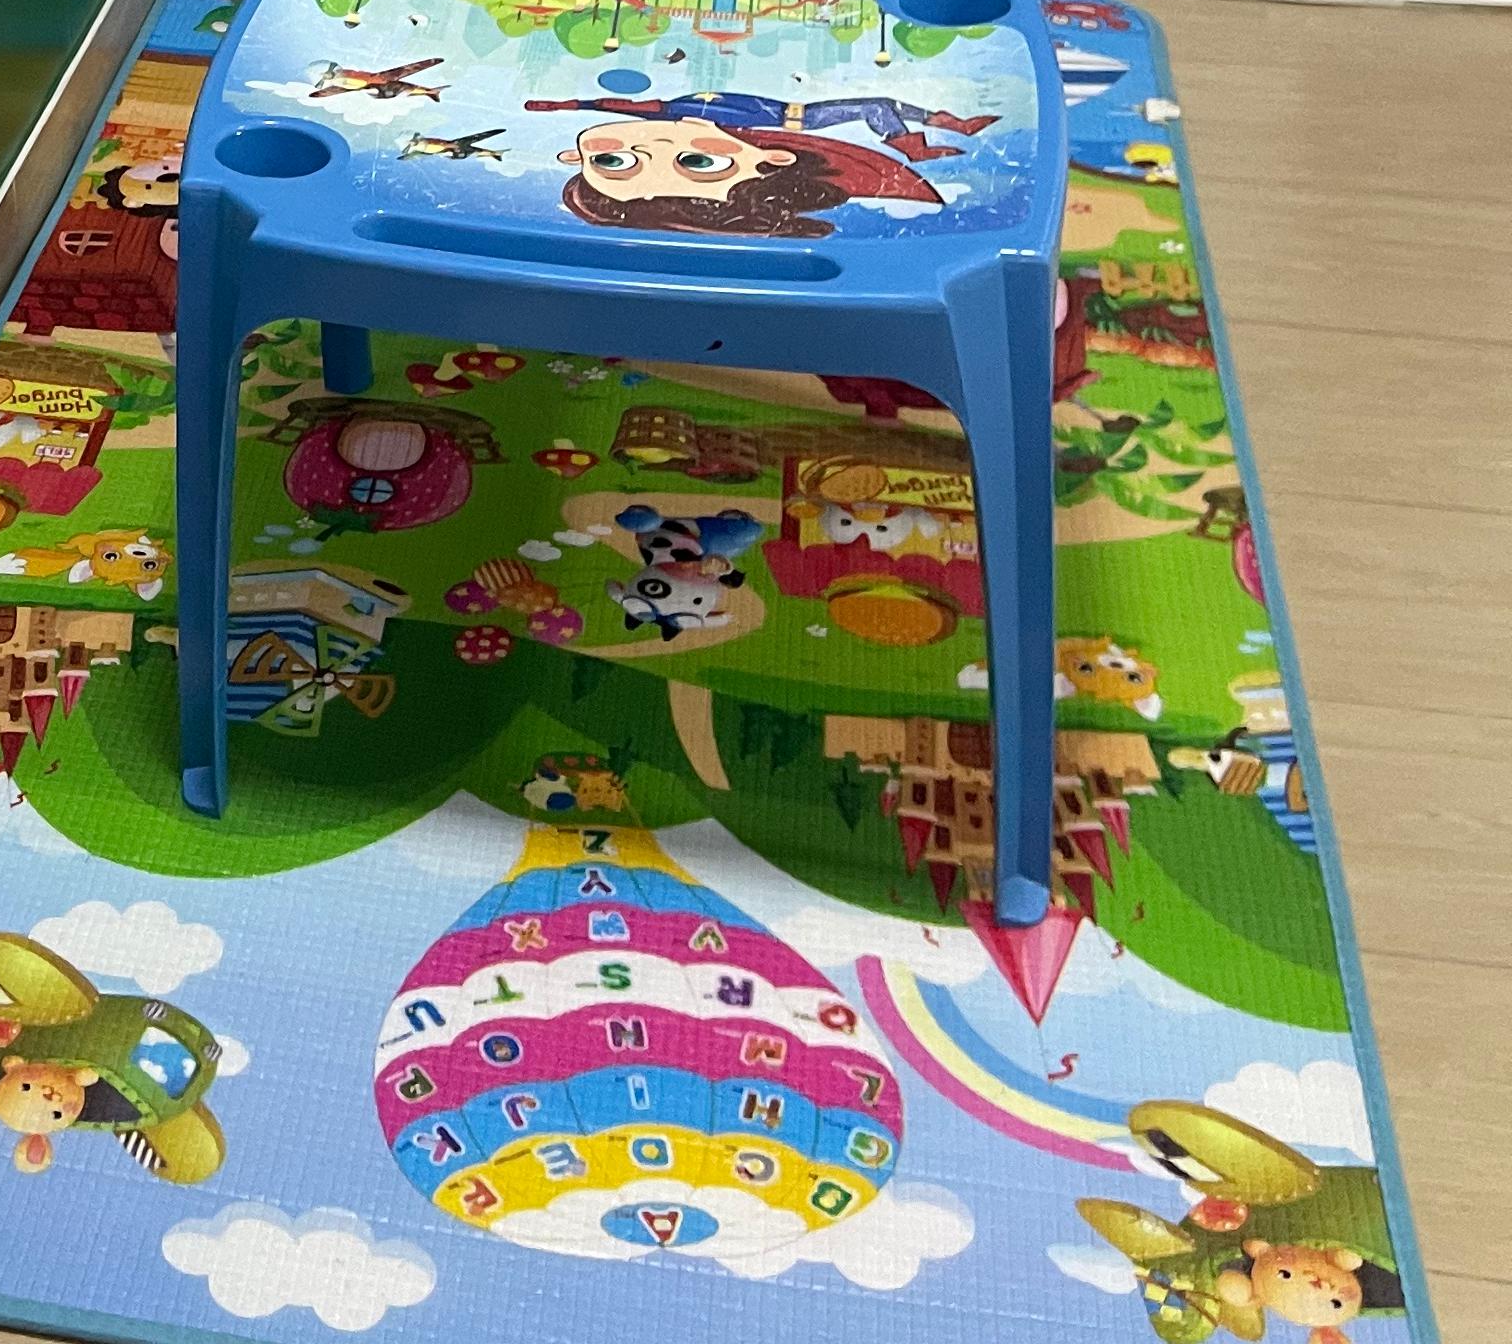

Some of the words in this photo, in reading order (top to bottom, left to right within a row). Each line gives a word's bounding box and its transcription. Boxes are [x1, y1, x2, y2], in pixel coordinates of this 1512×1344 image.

[39, 399, 92, 414] Ham
[582, 831, 614, 854] Z
[580, 870, 613, 896] Y
[507, 922, 544, 949] X
[692, 925, 724, 950] V
[490, 976, 523, 1003] T
[600, 964, 631, 990] S
[716, 977, 753, 1007] R
[403, 1002, 445, 1032] U
[818, 1006, 857, 1034] Q
[609, 1020, 643, 1046] N
[484, 1037, 519, 1063] O
[744, 1037, 783, 1061] M
[397, 1068, 430, 1098] P
[852, 1068, 882, 1105] L
[504, 1096, 536, 1125] J
[744, 1094, 781, 1127] H
[419, 1129, 460, 1161] K
[632, 1139, 671, 1166] D
[849, 1131, 888, 1164] G
[539, 1145, 585, 1177] E
[736, 1152, 774, 1178] C
[813, 1184, 850, 1214] B
[642, 1212, 679, 1242] A
